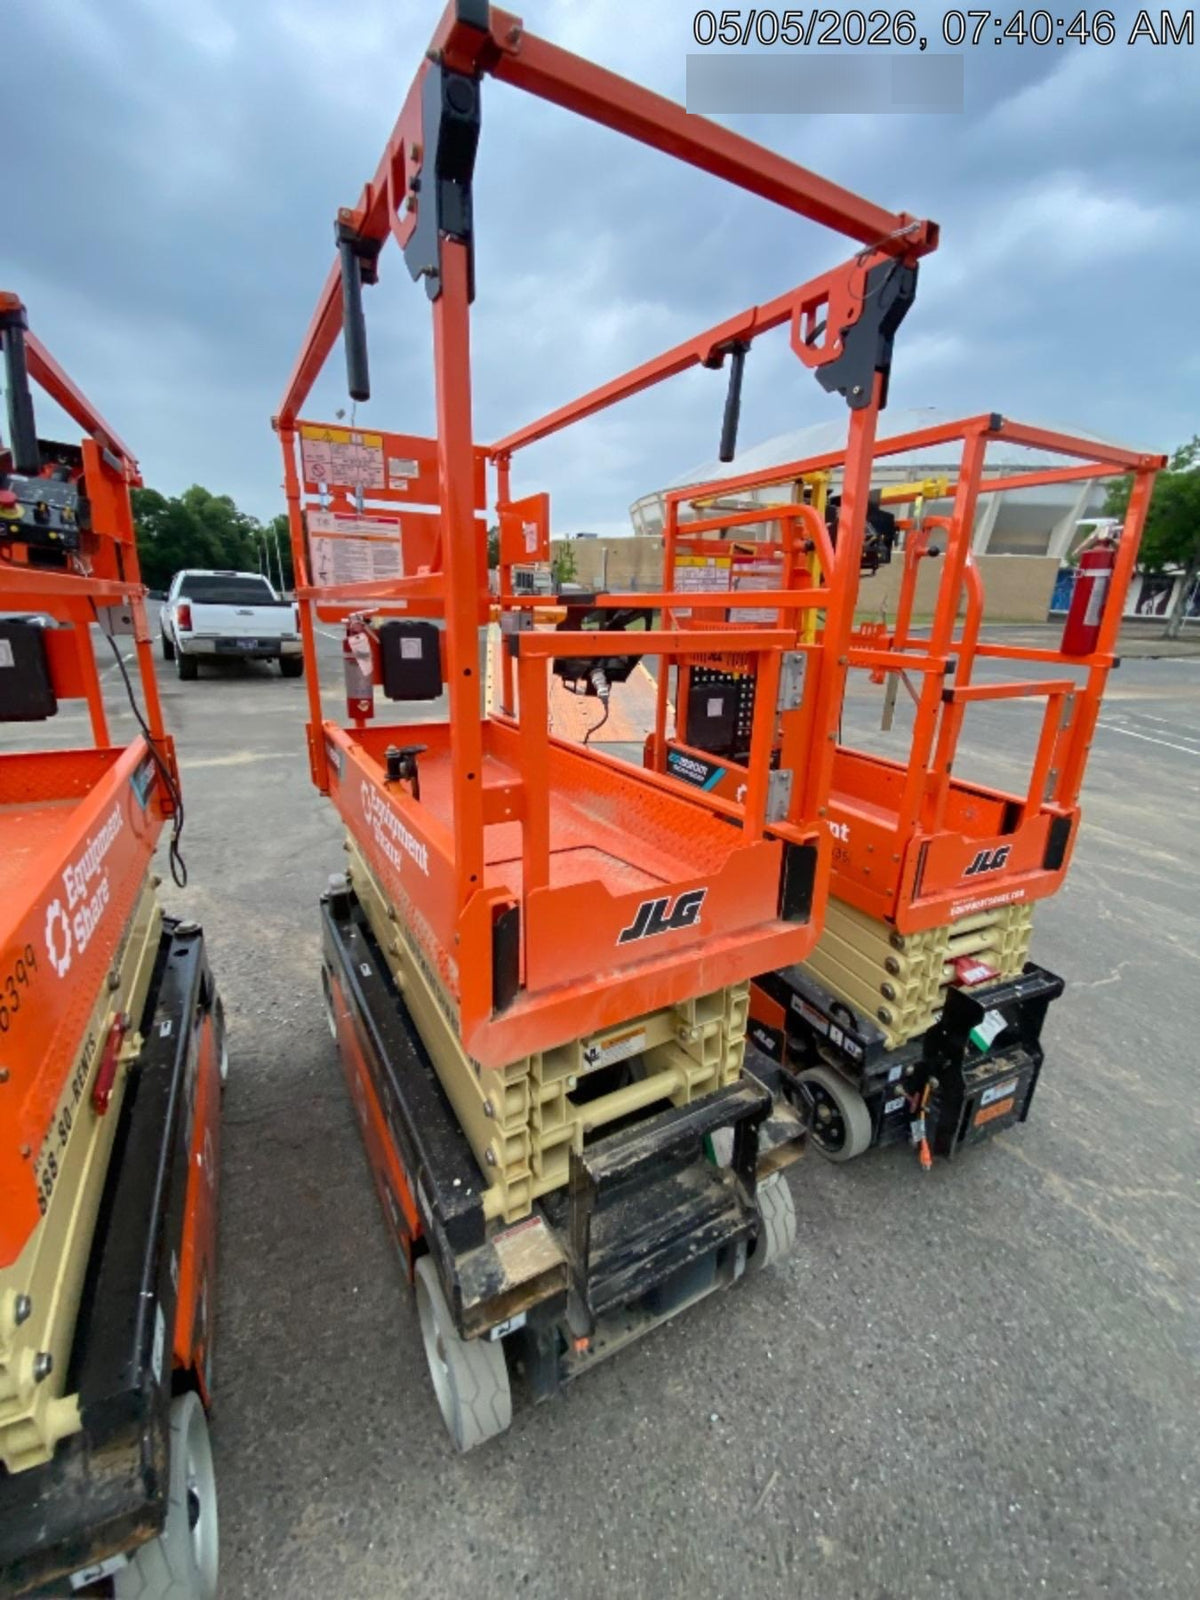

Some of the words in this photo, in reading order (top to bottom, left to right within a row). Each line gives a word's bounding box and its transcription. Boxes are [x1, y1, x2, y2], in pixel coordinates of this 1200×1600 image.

[62, 800, 123, 911] Equipment
[370, 783, 429, 877] Equipment
[373, 814, 401, 873] Share
[961, 844, 1013, 878] JLG
[73, 876, 109, 953] Share
[615, 886, 708, 946] JLG
